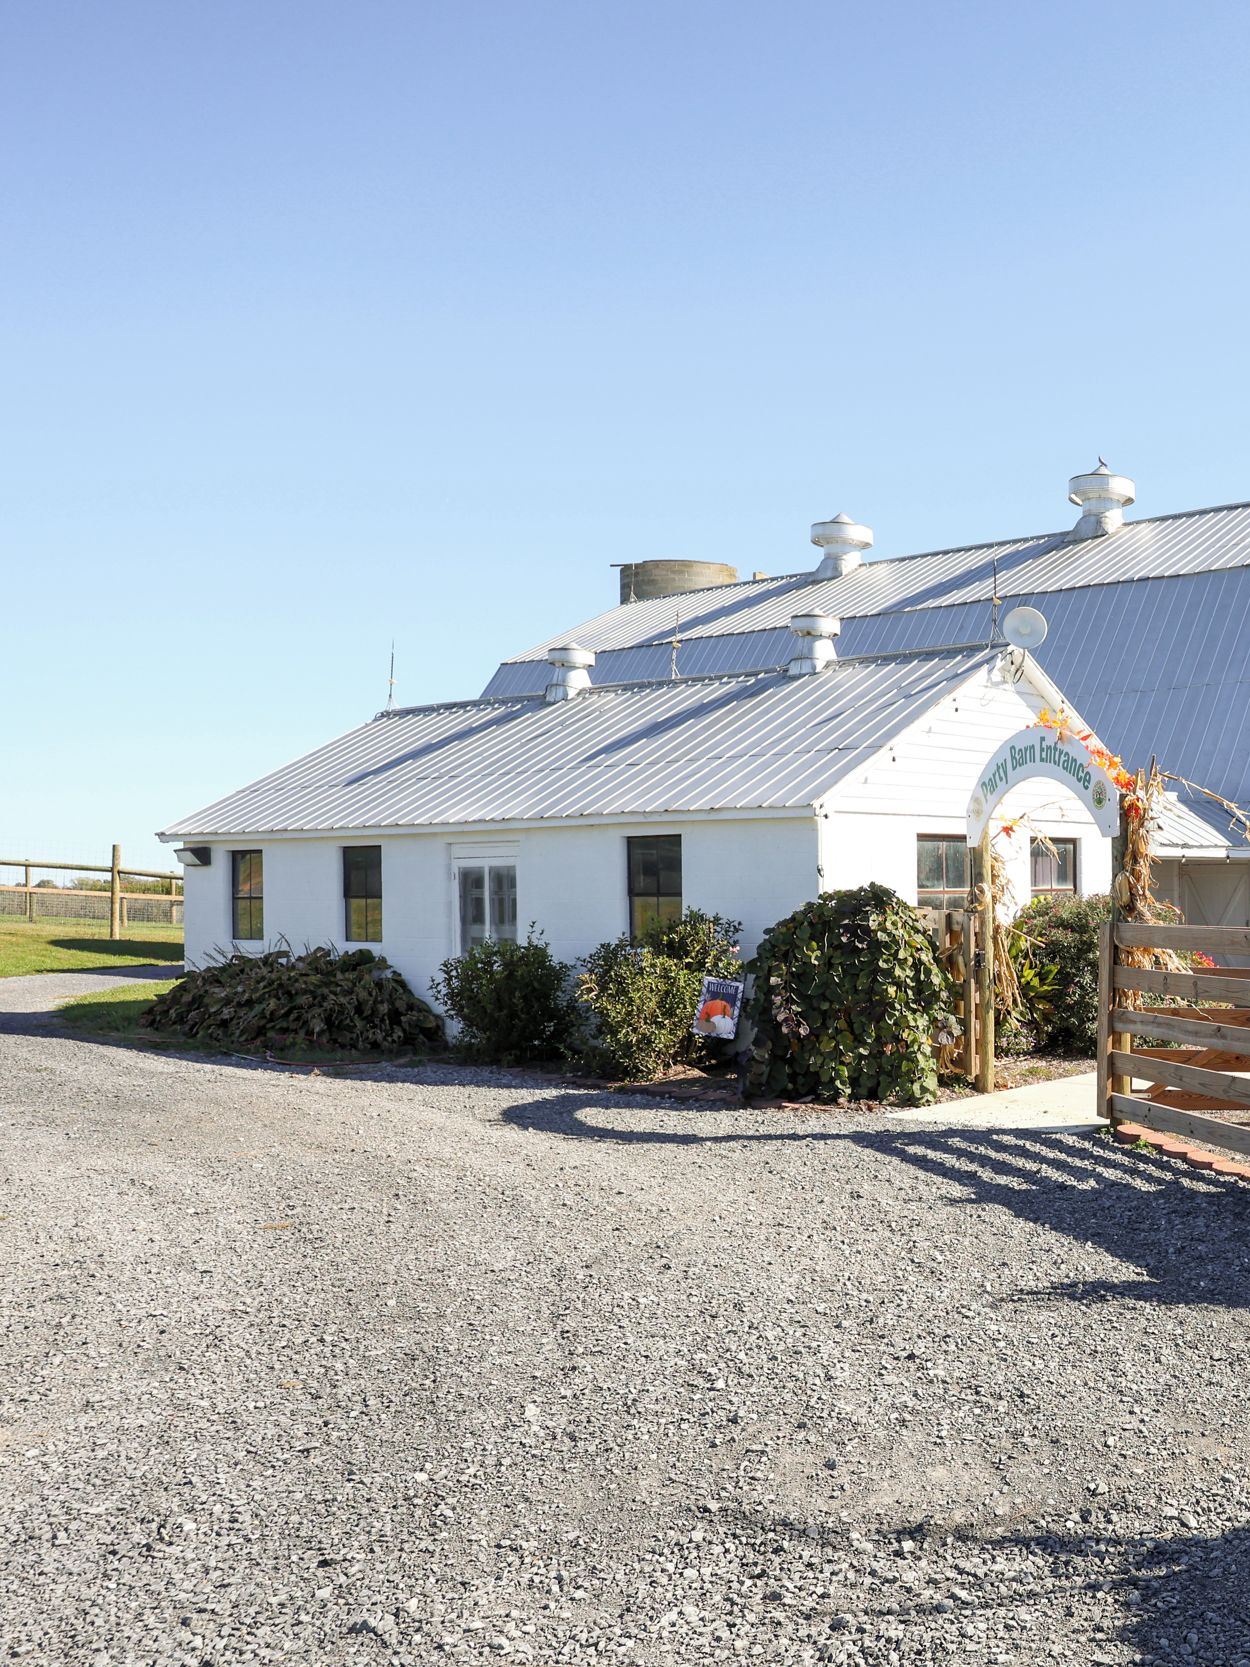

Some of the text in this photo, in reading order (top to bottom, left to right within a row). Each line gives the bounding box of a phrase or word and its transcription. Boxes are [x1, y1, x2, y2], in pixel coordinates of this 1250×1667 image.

[981, 736, 1092, 803] Party Barn Entrance
[709, 982, 736, 994] WELCOME
